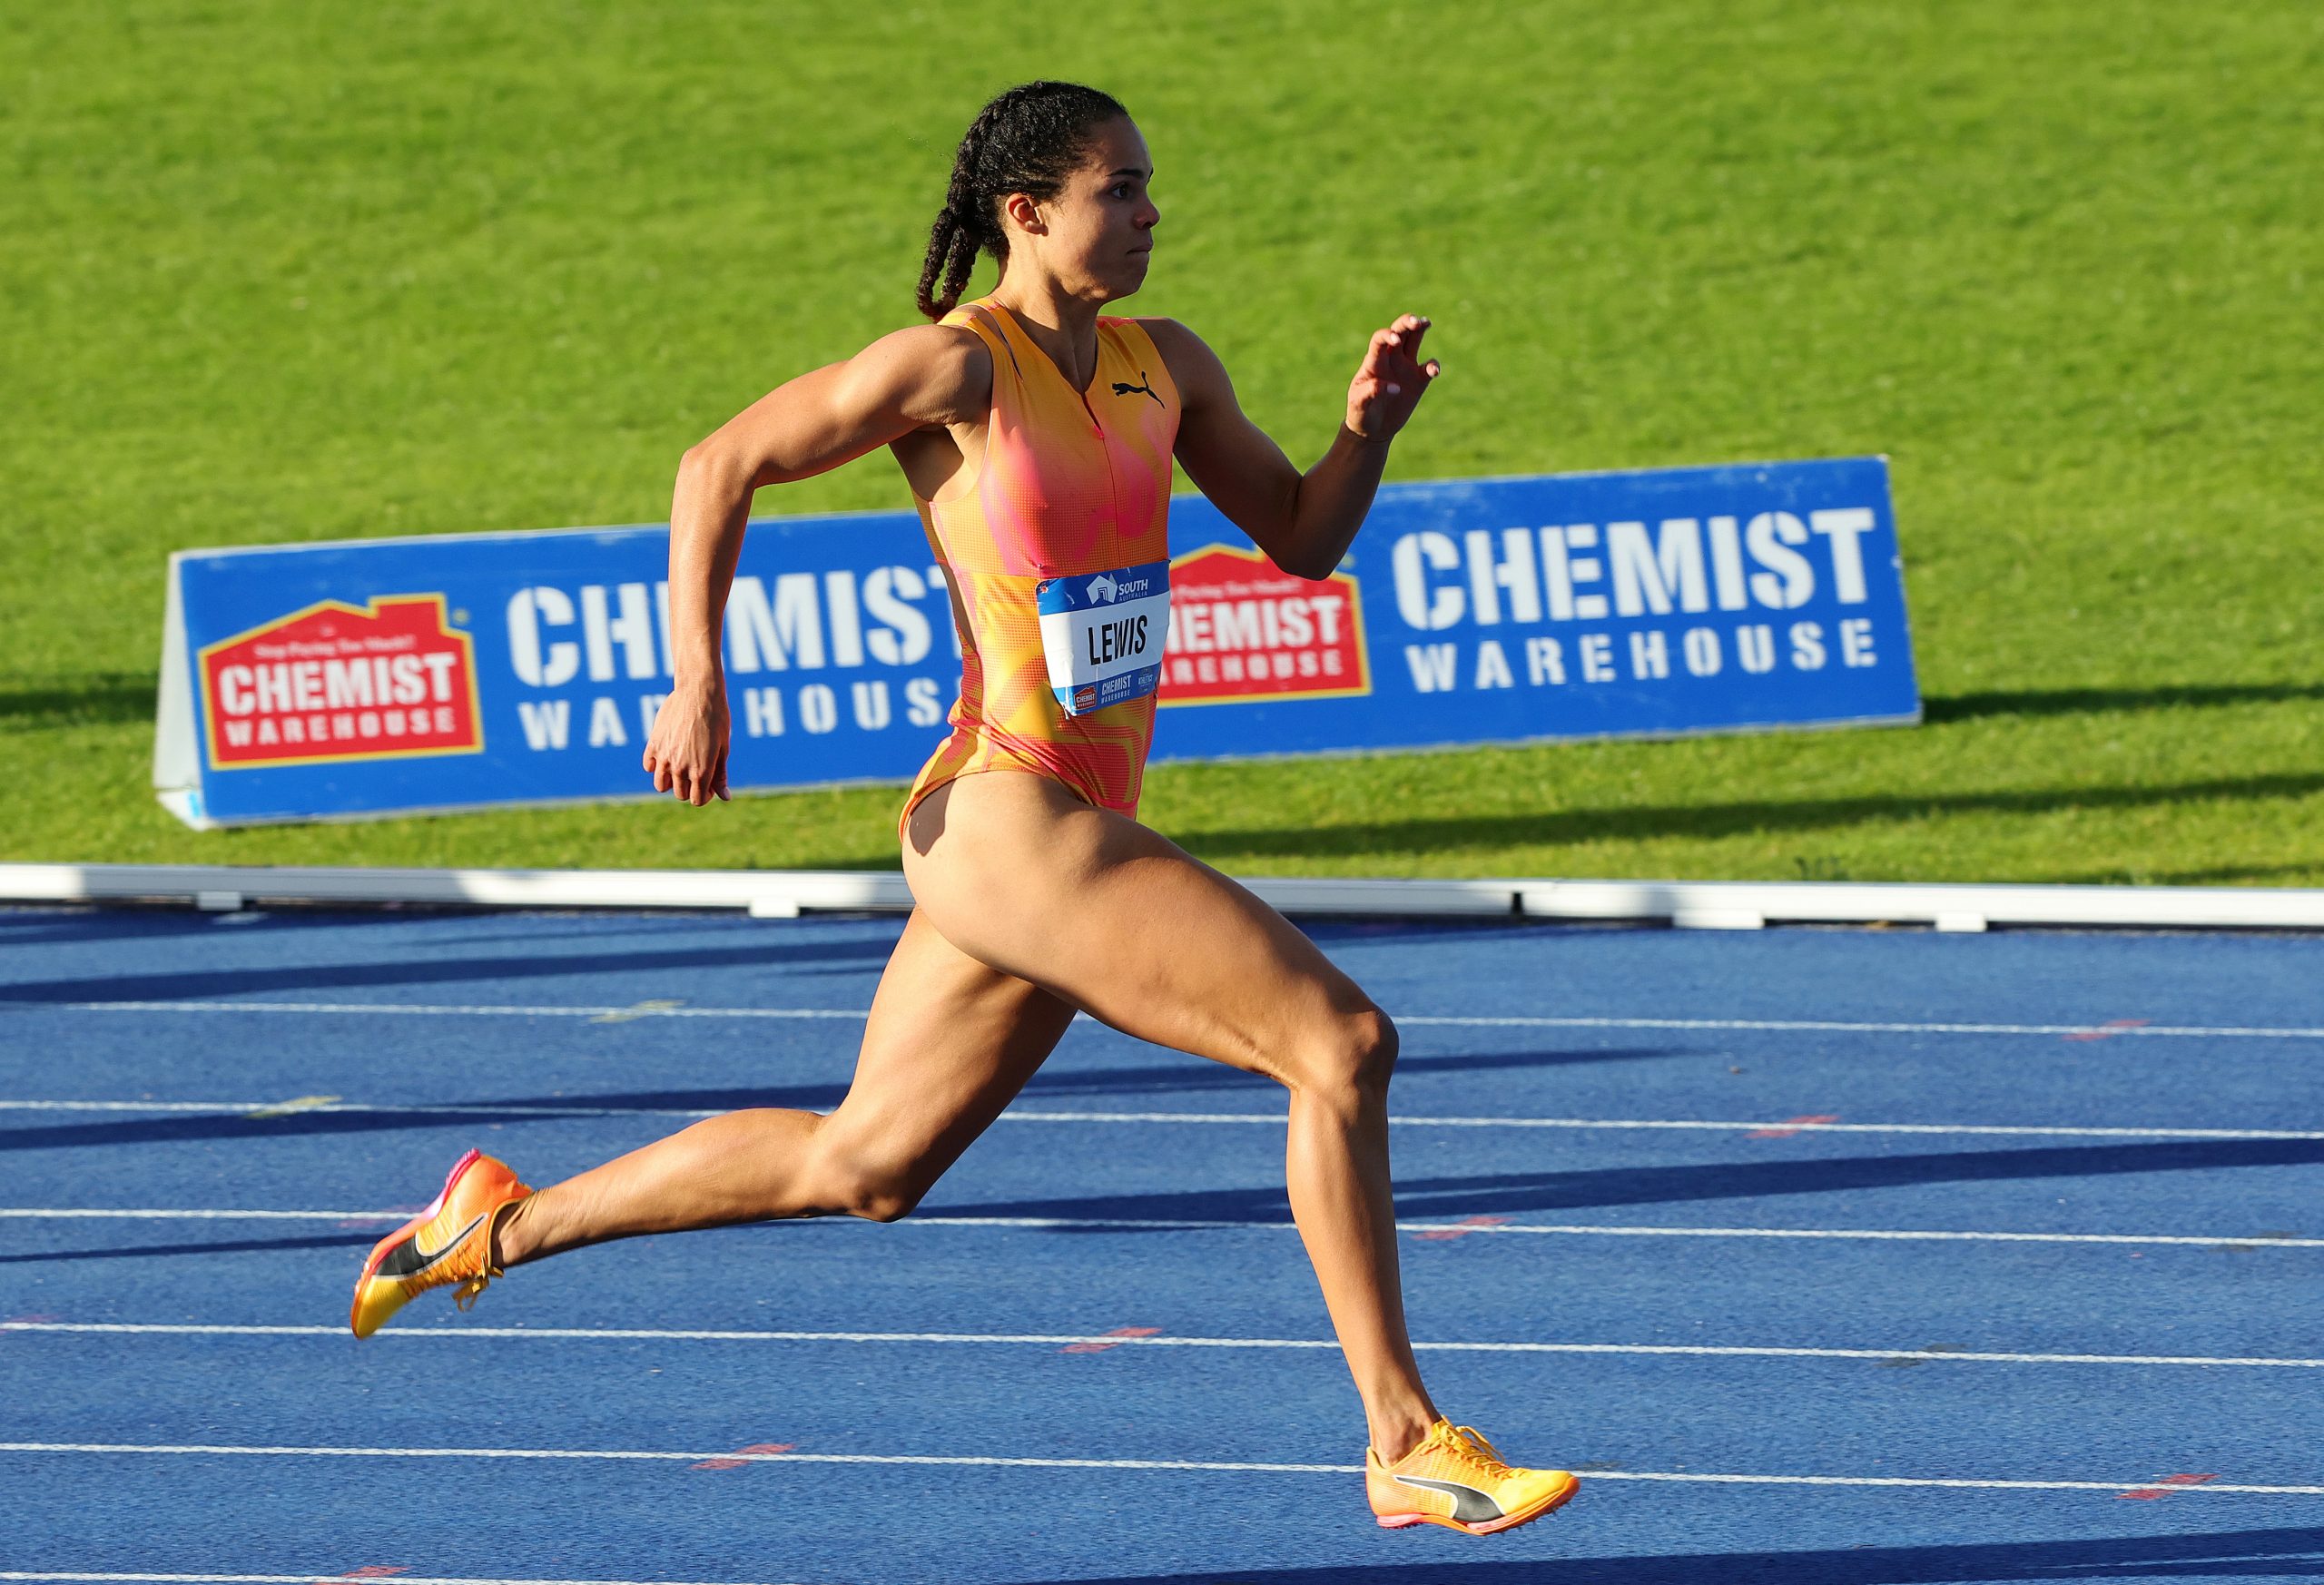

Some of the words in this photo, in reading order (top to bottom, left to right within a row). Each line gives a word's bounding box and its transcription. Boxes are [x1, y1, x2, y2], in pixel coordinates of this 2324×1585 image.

[1118, 579, 1148, 596] SOUTH
[1392, 507, 1875, 630] CHEMIST
[1118, 591, 1148, 602] AUSTRALIA
[1088, 615, 1147, 666] LEWIS
[1405, 618, 1877, 694] WAREHOUSE
[218, 652, 457, 716] CHEMIST
[1101, 674, 1132, 696] CHEMIST
[224, 705, 456, 747] WAREHOUSE
